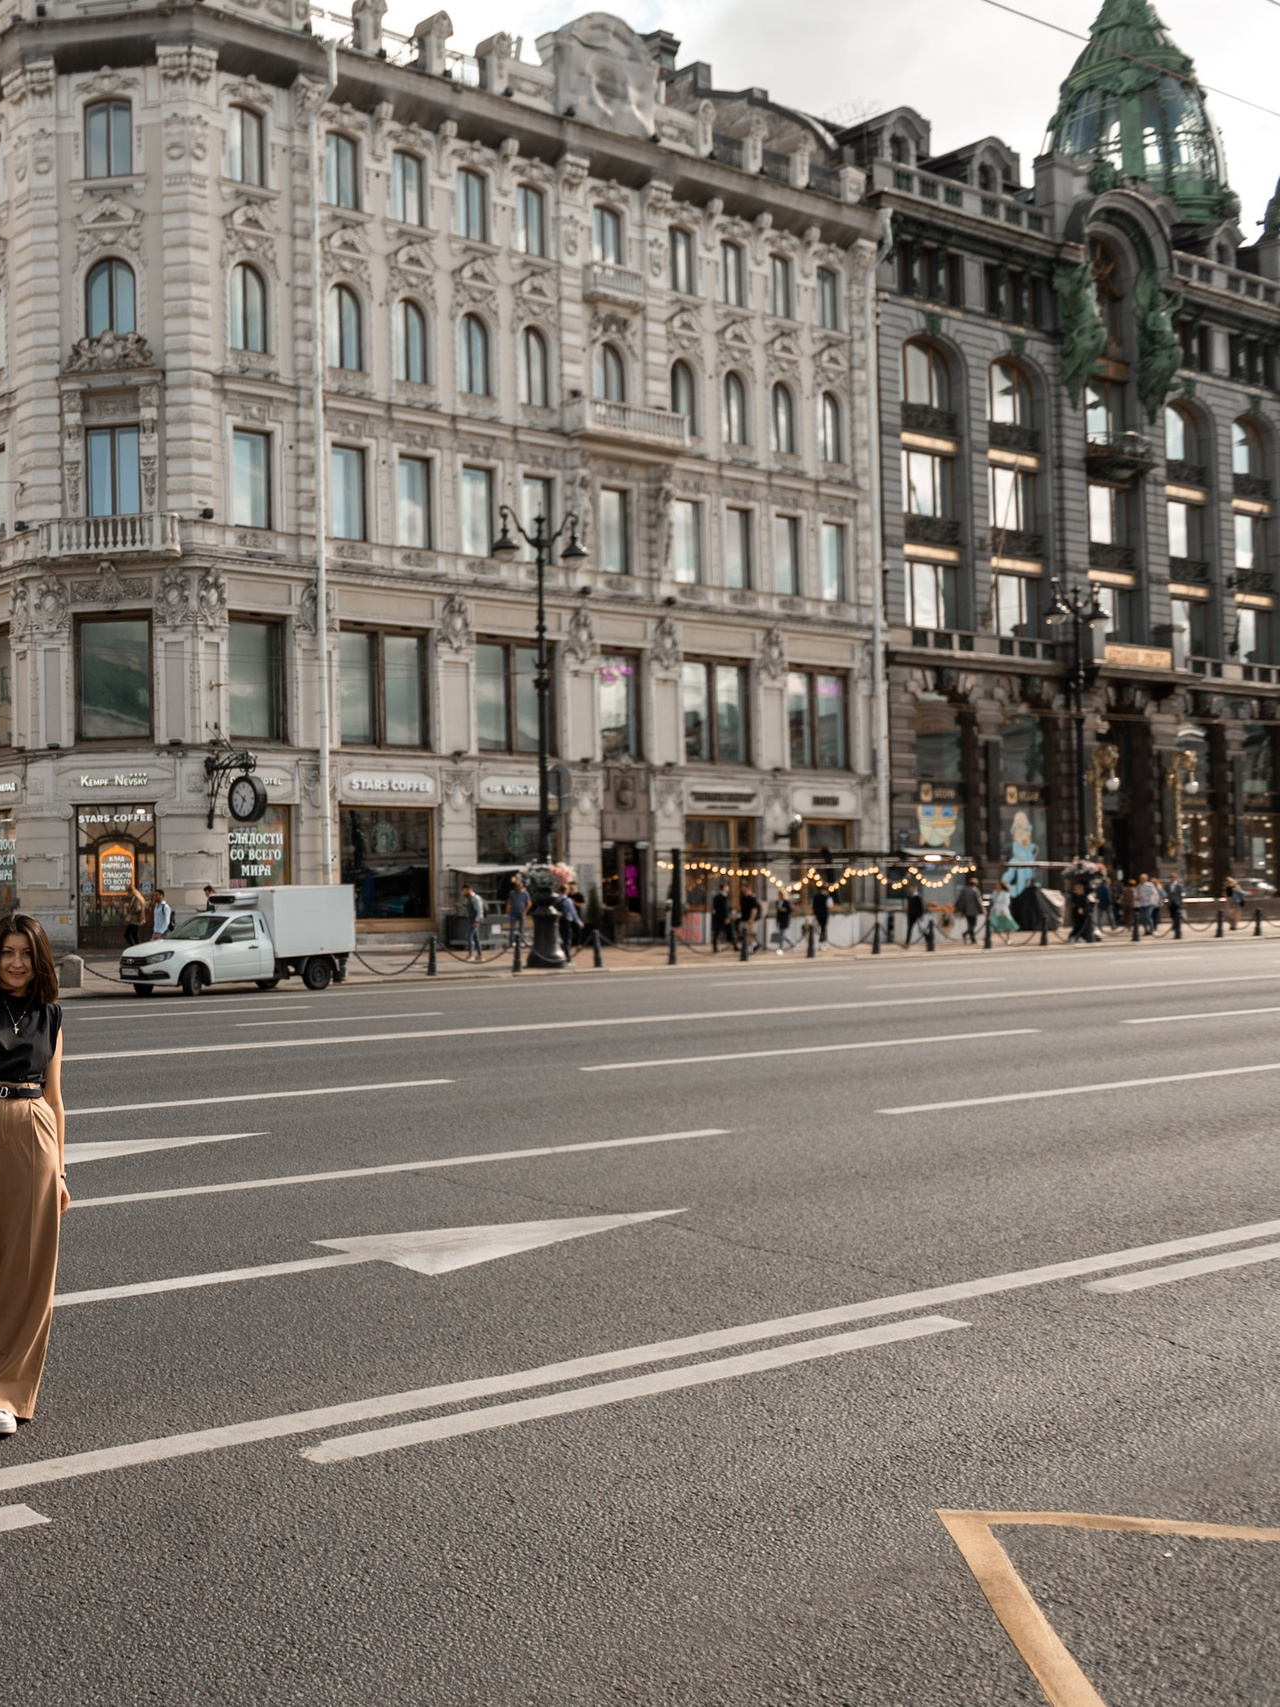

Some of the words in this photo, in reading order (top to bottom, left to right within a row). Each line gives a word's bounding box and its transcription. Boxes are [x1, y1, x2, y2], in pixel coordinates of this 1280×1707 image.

[350, 778, 389, 791] STARS
[391, 779, 432, 793] COFFEE
[78, 813, 110, 824] STARS
[113, 813, 153, 823] COFFEE
[228, 833, 284, 845] СЛАДОСТИ
[230, 849, 245, 860] СО
[249, 849, 282, 860] ВСЕГО
[241, 865, 272, 876] МИРА
